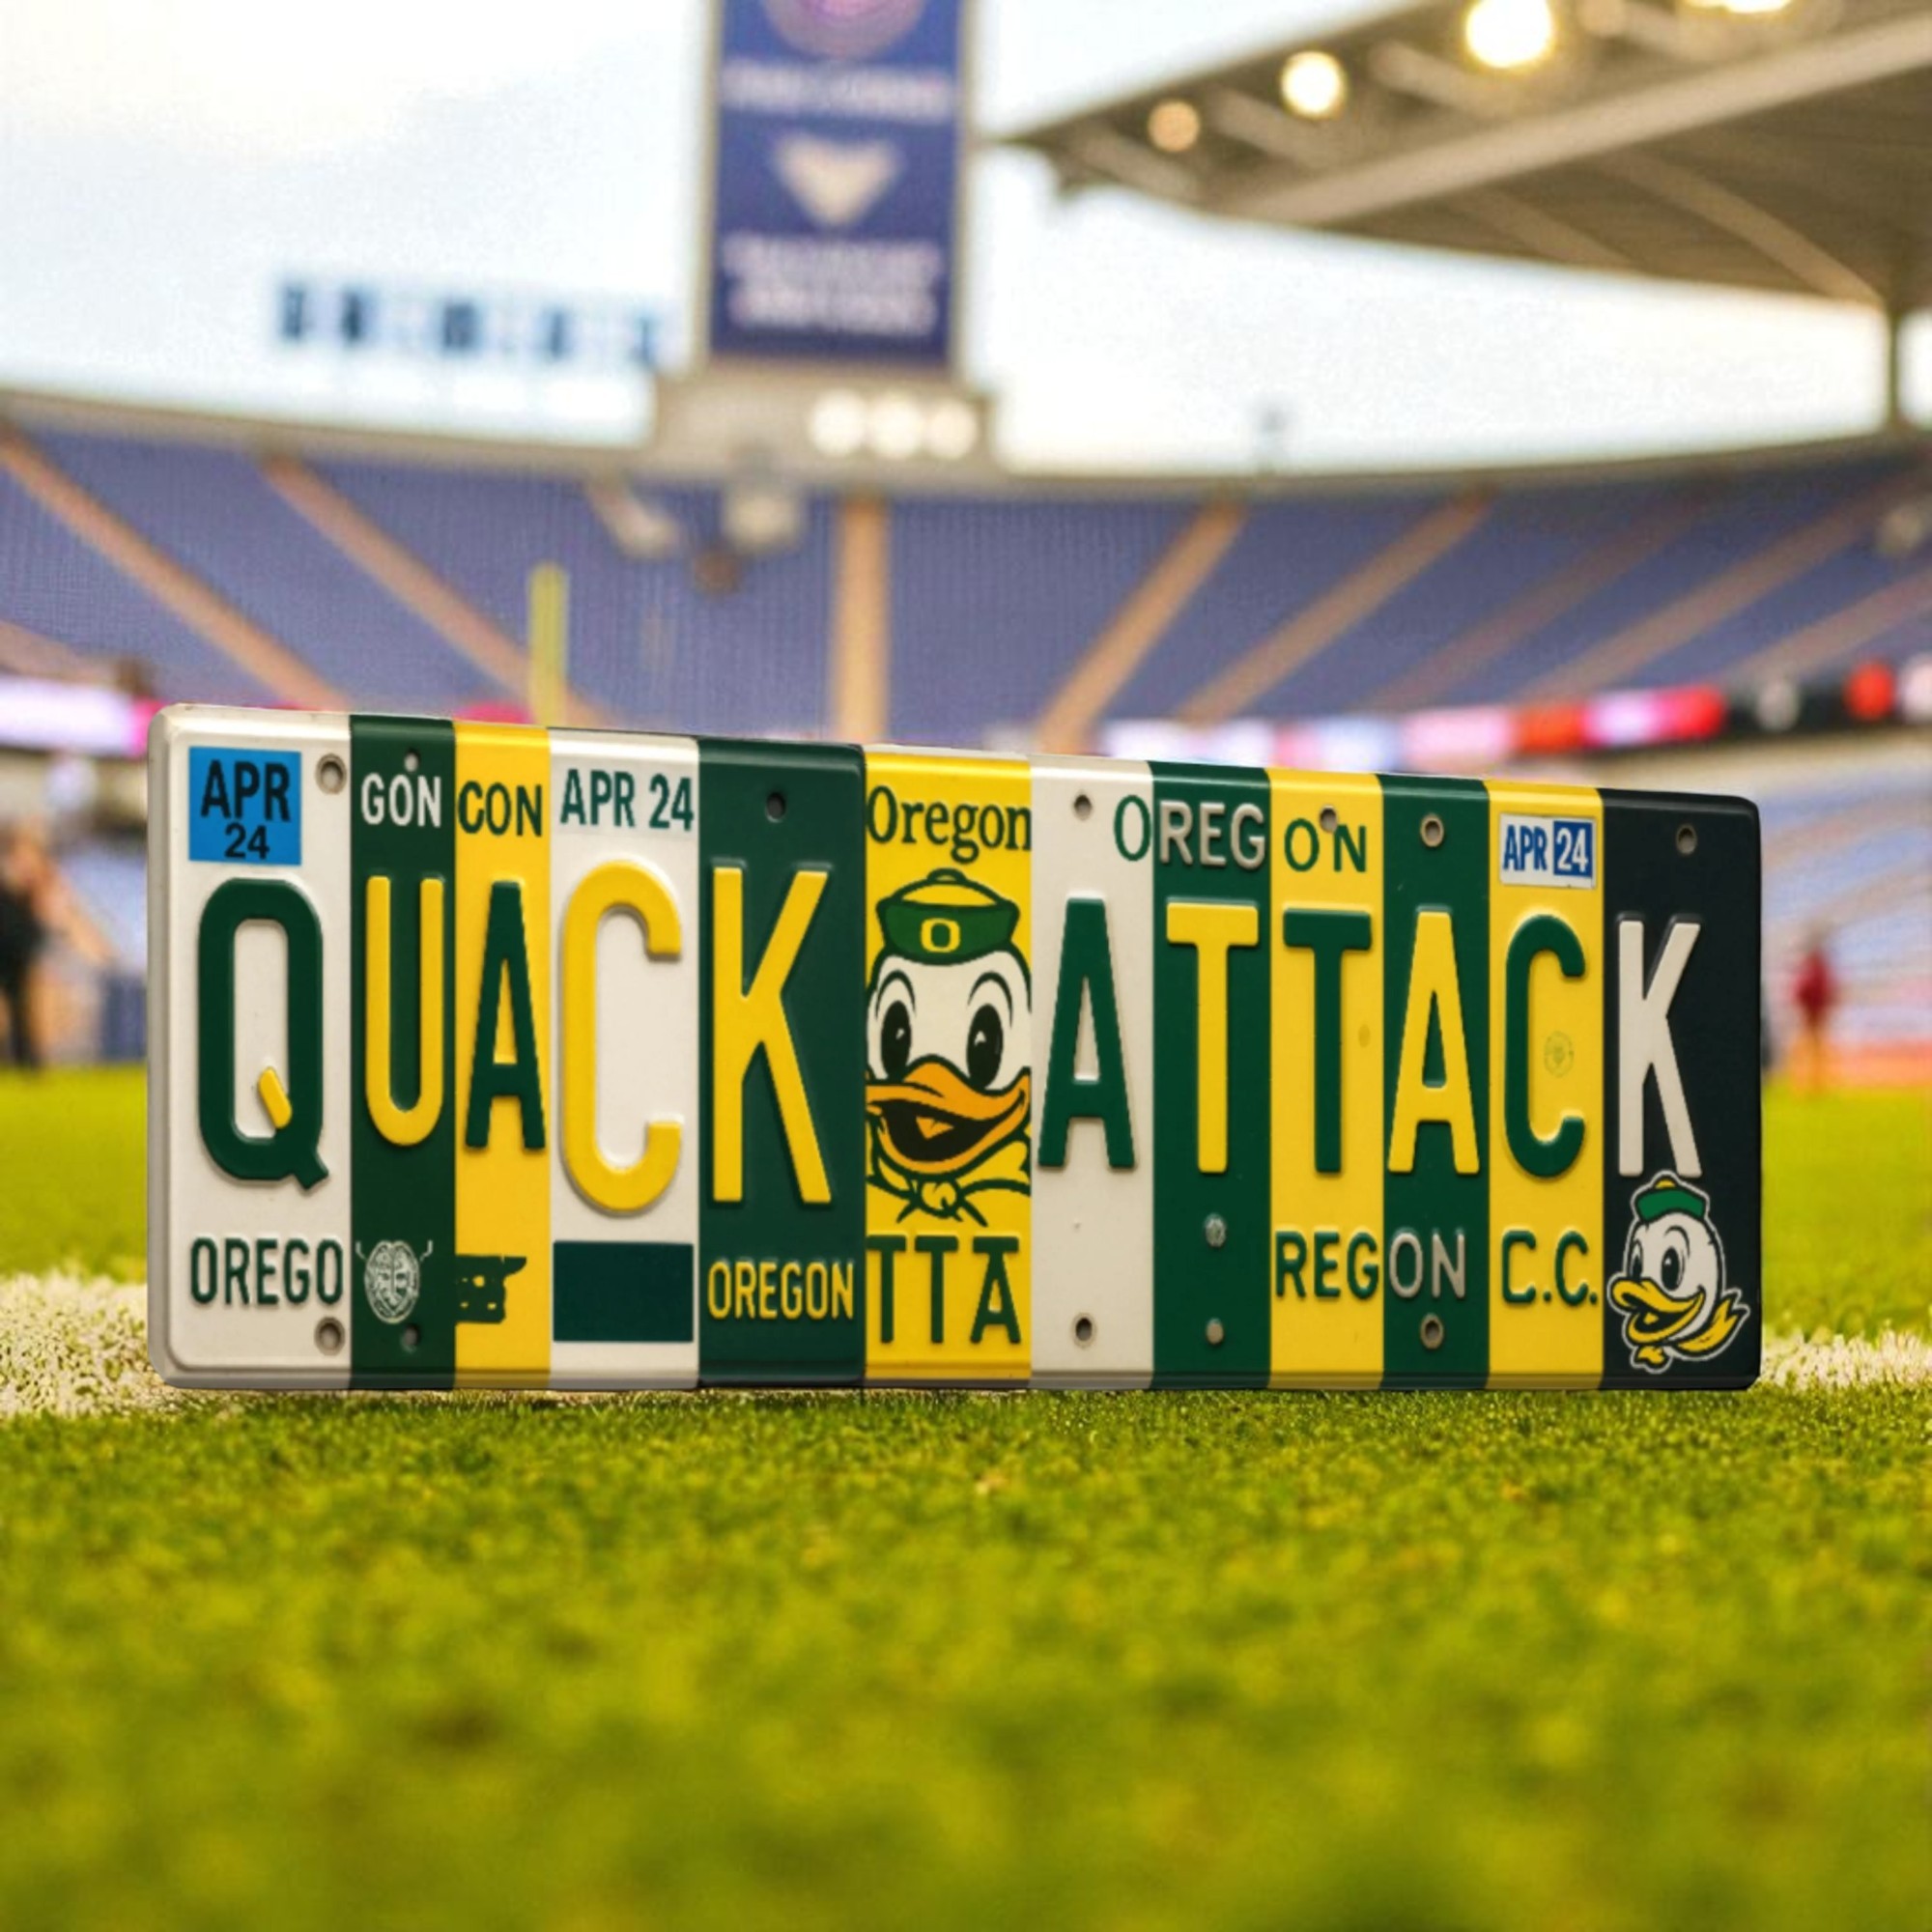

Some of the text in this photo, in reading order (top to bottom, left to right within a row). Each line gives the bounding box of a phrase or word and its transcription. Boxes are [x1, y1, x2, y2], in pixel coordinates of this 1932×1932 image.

[200, 760, 290, 821] APR
[360, 773, 441, 828] GON
[458, 781, 543, 837] CON
[560, 769, 694, 831] APR 24
[224, 824, 270, 859] 24
[867, 785, 1032, 864] Oregon
[1502, 824, 1590, 873] APR 24
[921, 918, 960, 952] O
[196, 860, 1702, 1212] QUACK ATTACK
[191, 1236, 343, 1305] OREGO
[707, 1261, 854, 1320] OREGON
[867, 1234, 1022, 1344] TTA
